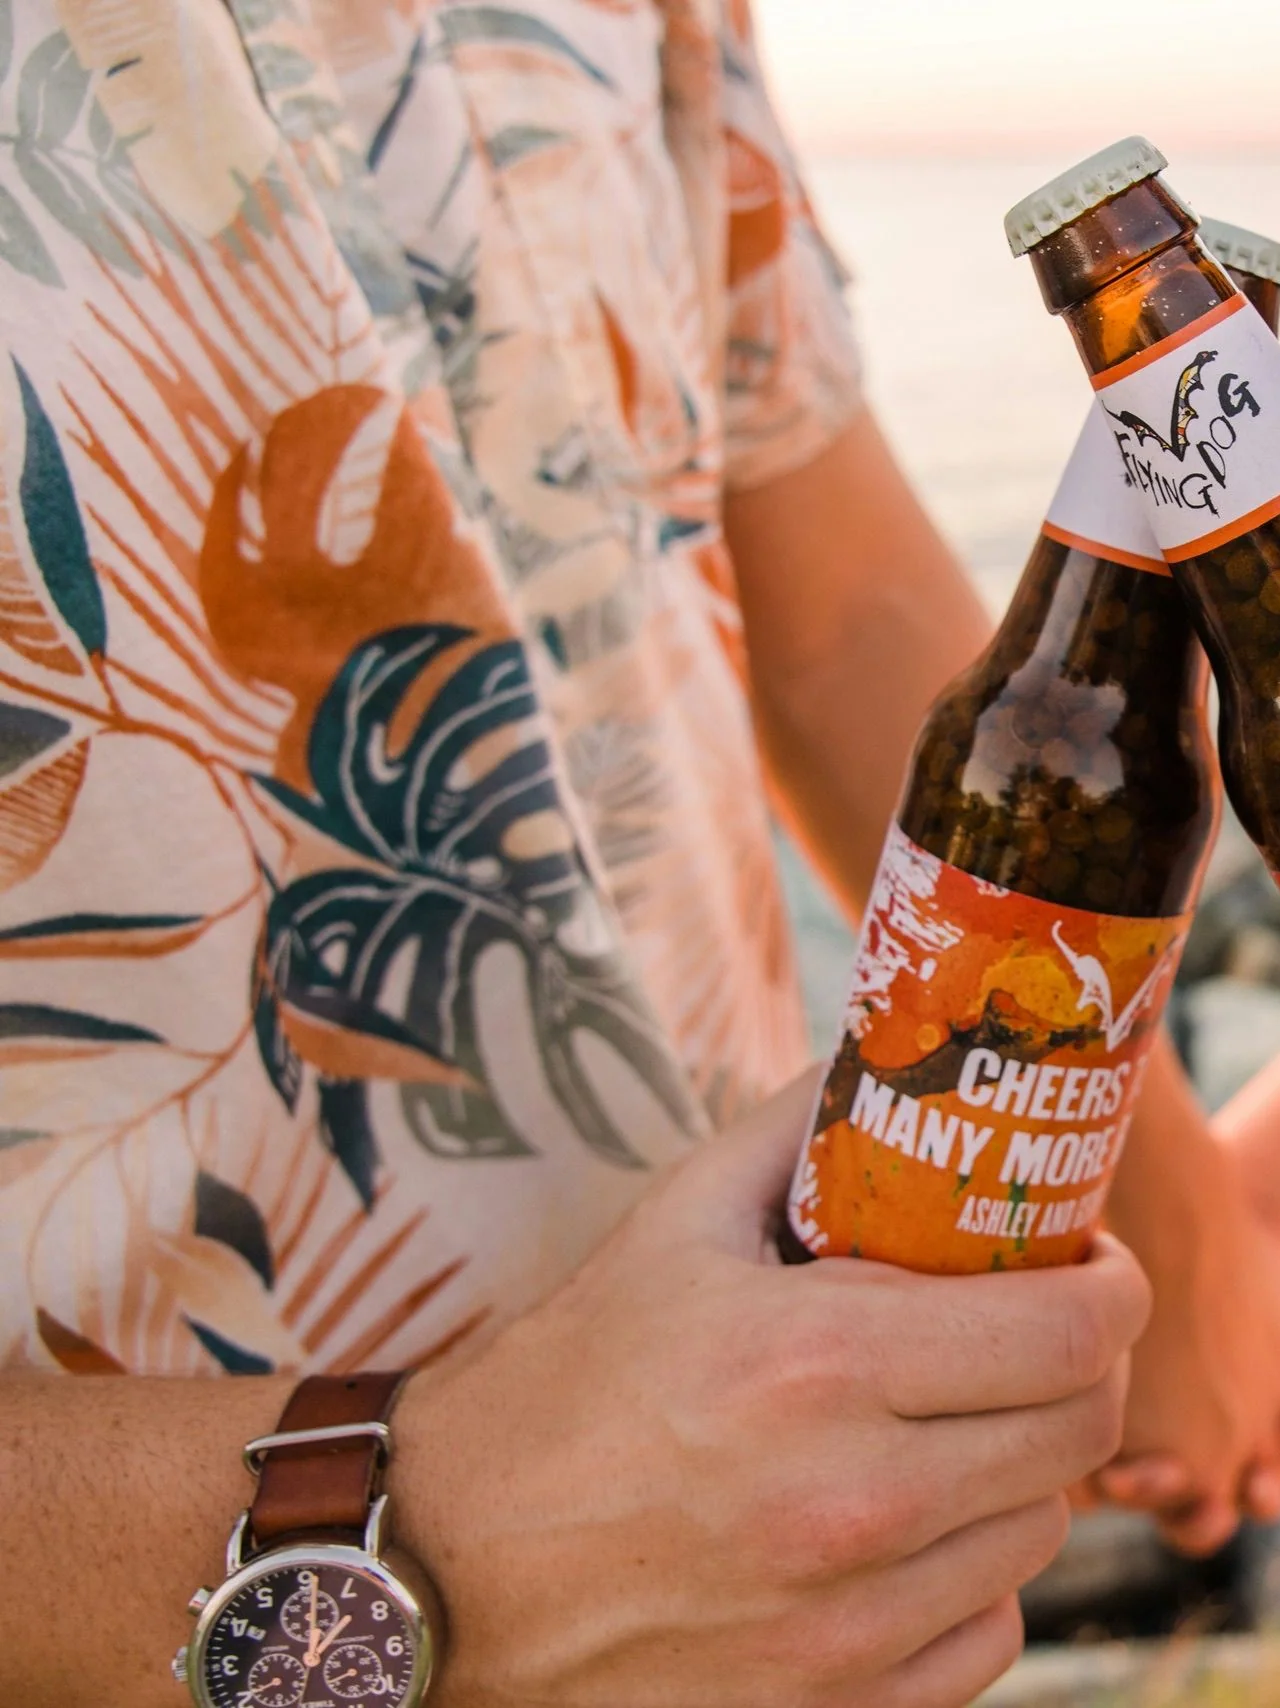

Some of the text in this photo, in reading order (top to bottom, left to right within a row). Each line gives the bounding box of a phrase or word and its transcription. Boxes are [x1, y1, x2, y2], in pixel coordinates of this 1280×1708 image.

[1113, 373, 1261, 518] FLYING DOG
[957, 1047, 1130, 1120] CHEERS
[848, 1071, 995, 1177] MANY
[999, 1125, 1116, 1187] MORE
[956, 1194, 1041, 1239] ASHLEY
[256, 1587, 273, 1608] 5
[340, 1578, 357, 1598] 7
[371, 1601, 388, 1621] 8
[230, 1617, 248, 1637] 4
[385, 1636, 404, 1656] 9
[221, 1655, 239, 1676] 3
